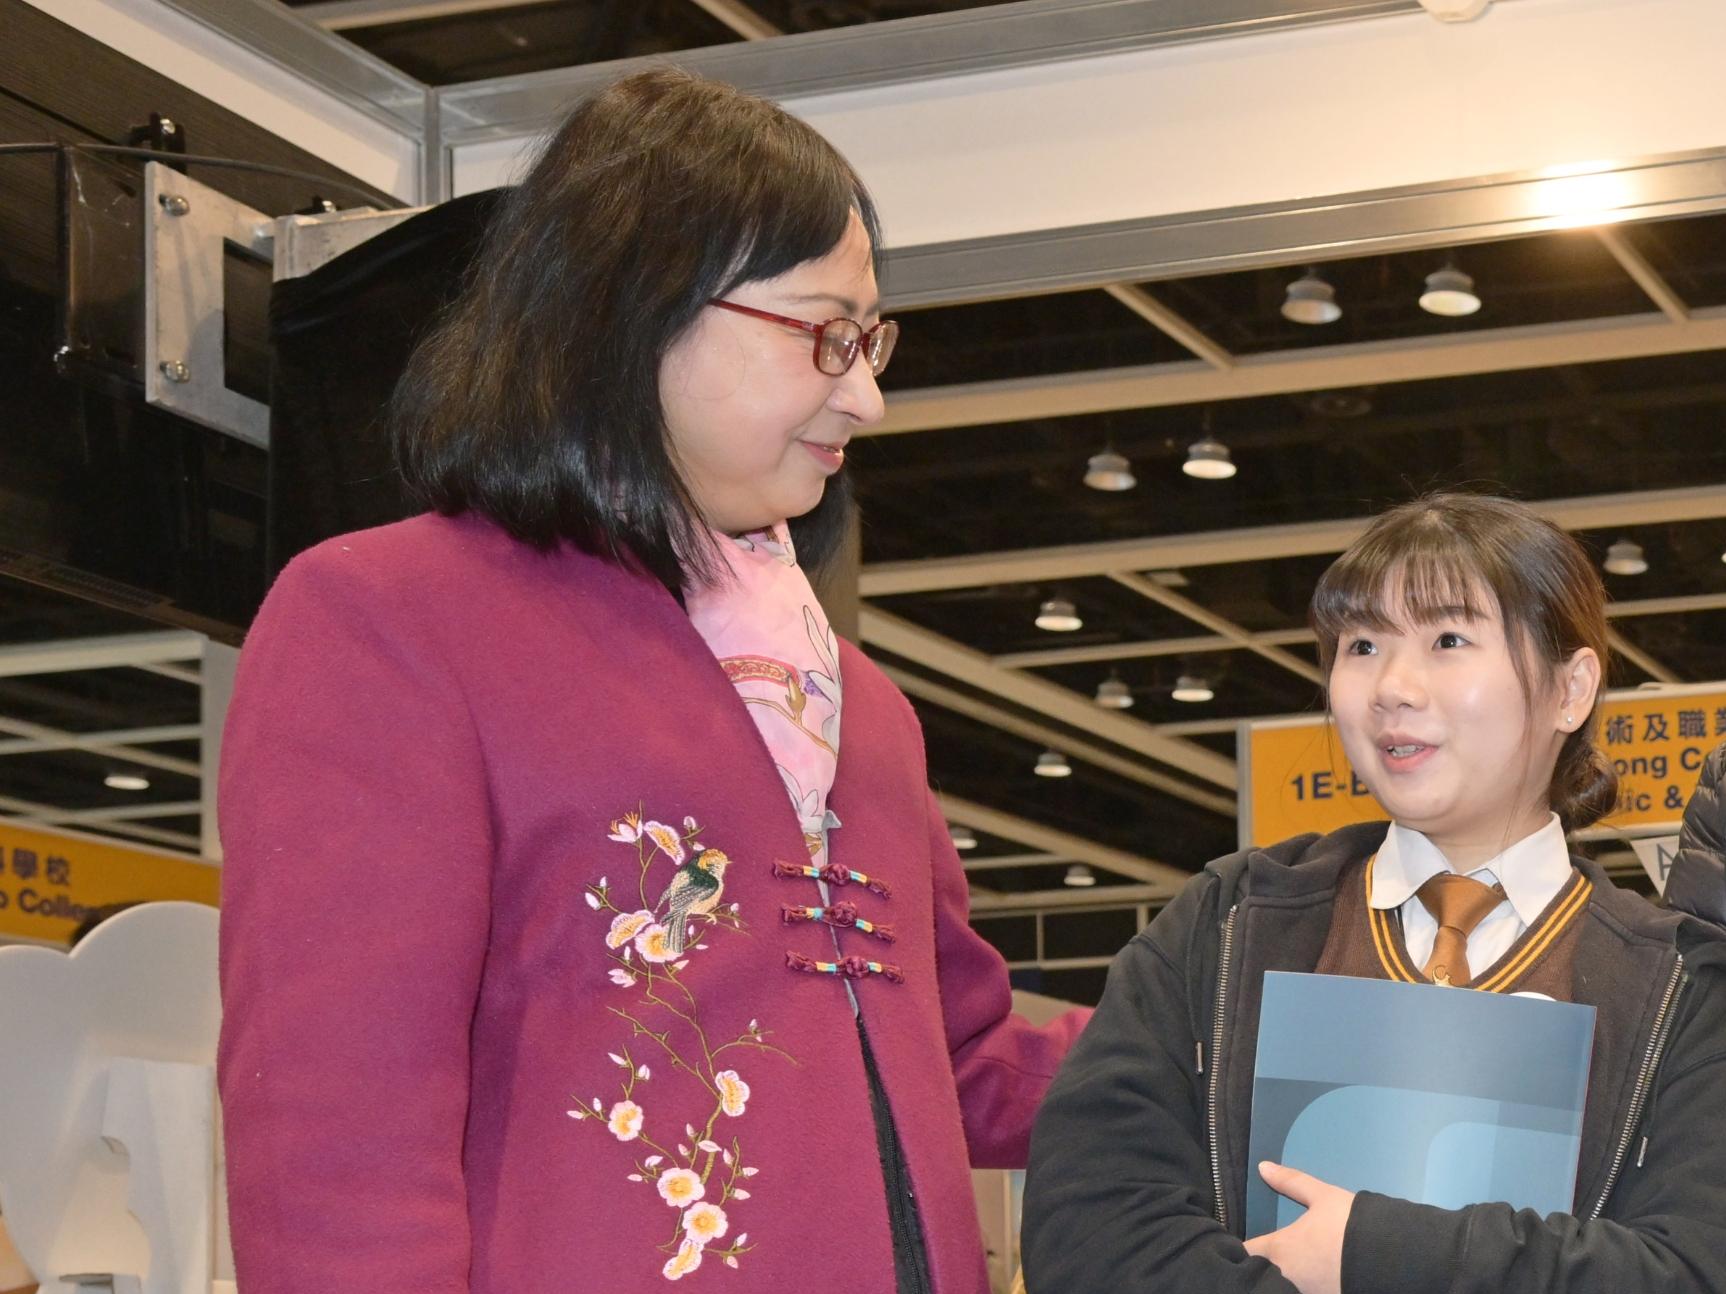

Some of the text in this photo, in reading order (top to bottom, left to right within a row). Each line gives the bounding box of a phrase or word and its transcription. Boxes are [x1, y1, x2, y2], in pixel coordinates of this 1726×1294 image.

[1612, 755, 1668, 778] ong
[1291, 770, 1369, 801] 1E-B
[1664, 785, 1684, 810] &
